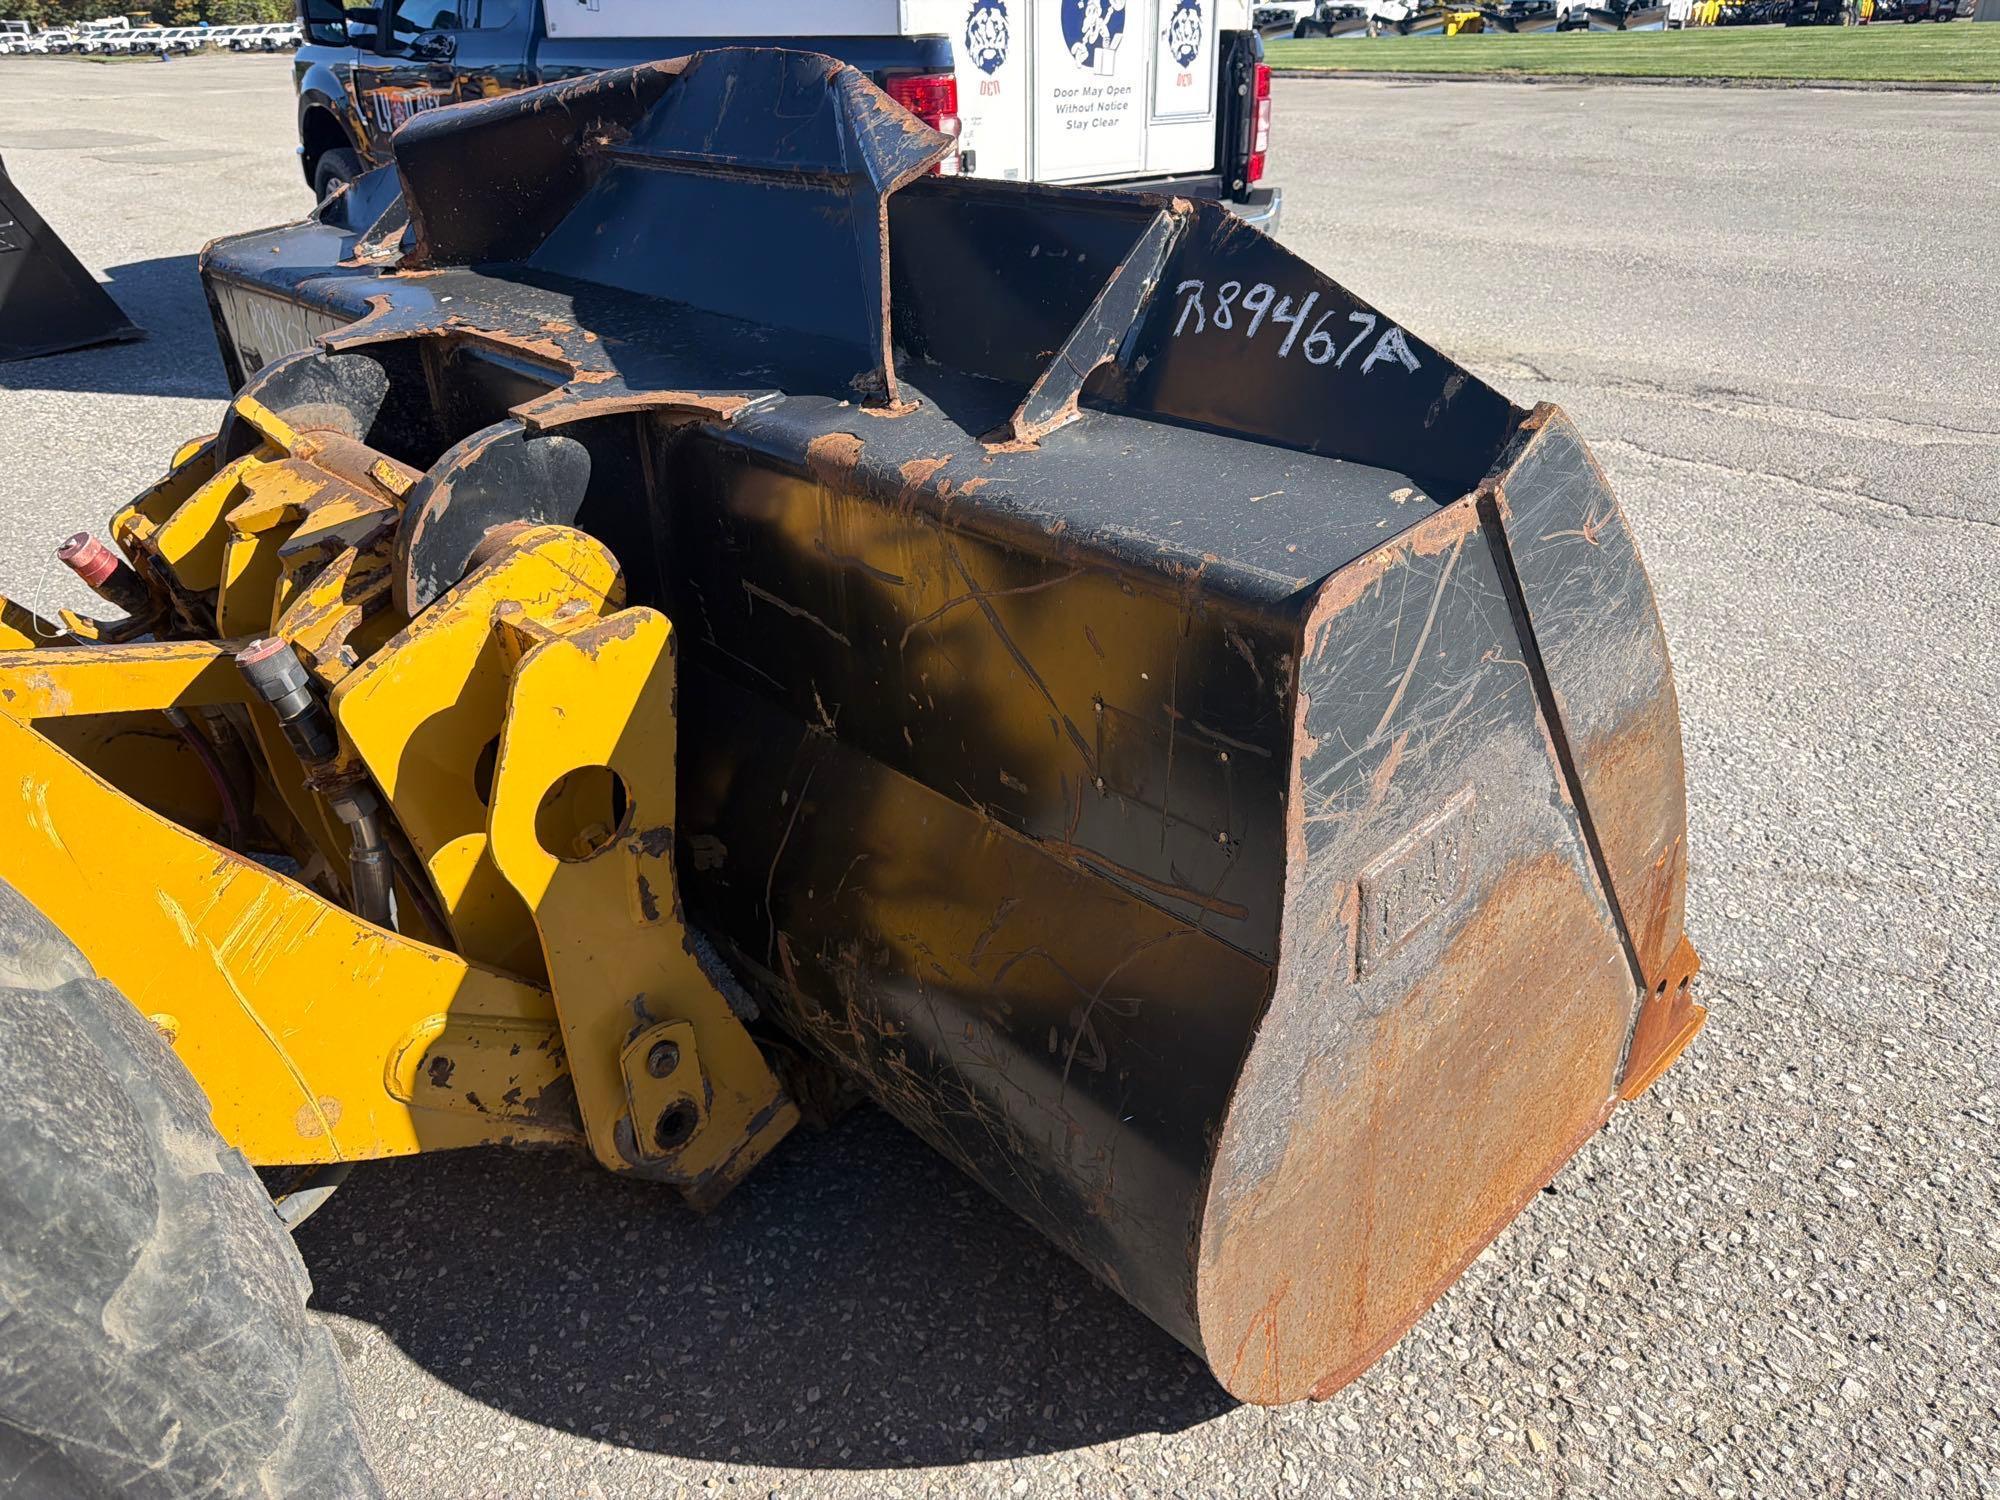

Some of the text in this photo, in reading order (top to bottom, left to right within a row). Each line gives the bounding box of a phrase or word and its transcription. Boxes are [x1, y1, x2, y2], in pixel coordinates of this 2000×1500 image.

[1053, 85, 1132, 98] Door May Open
[1056, 101, 1129, 114] Without Notice
[1066, 117, 1120, 131] Stay Clear
[1172, 278, 1423, 376] R89467A
